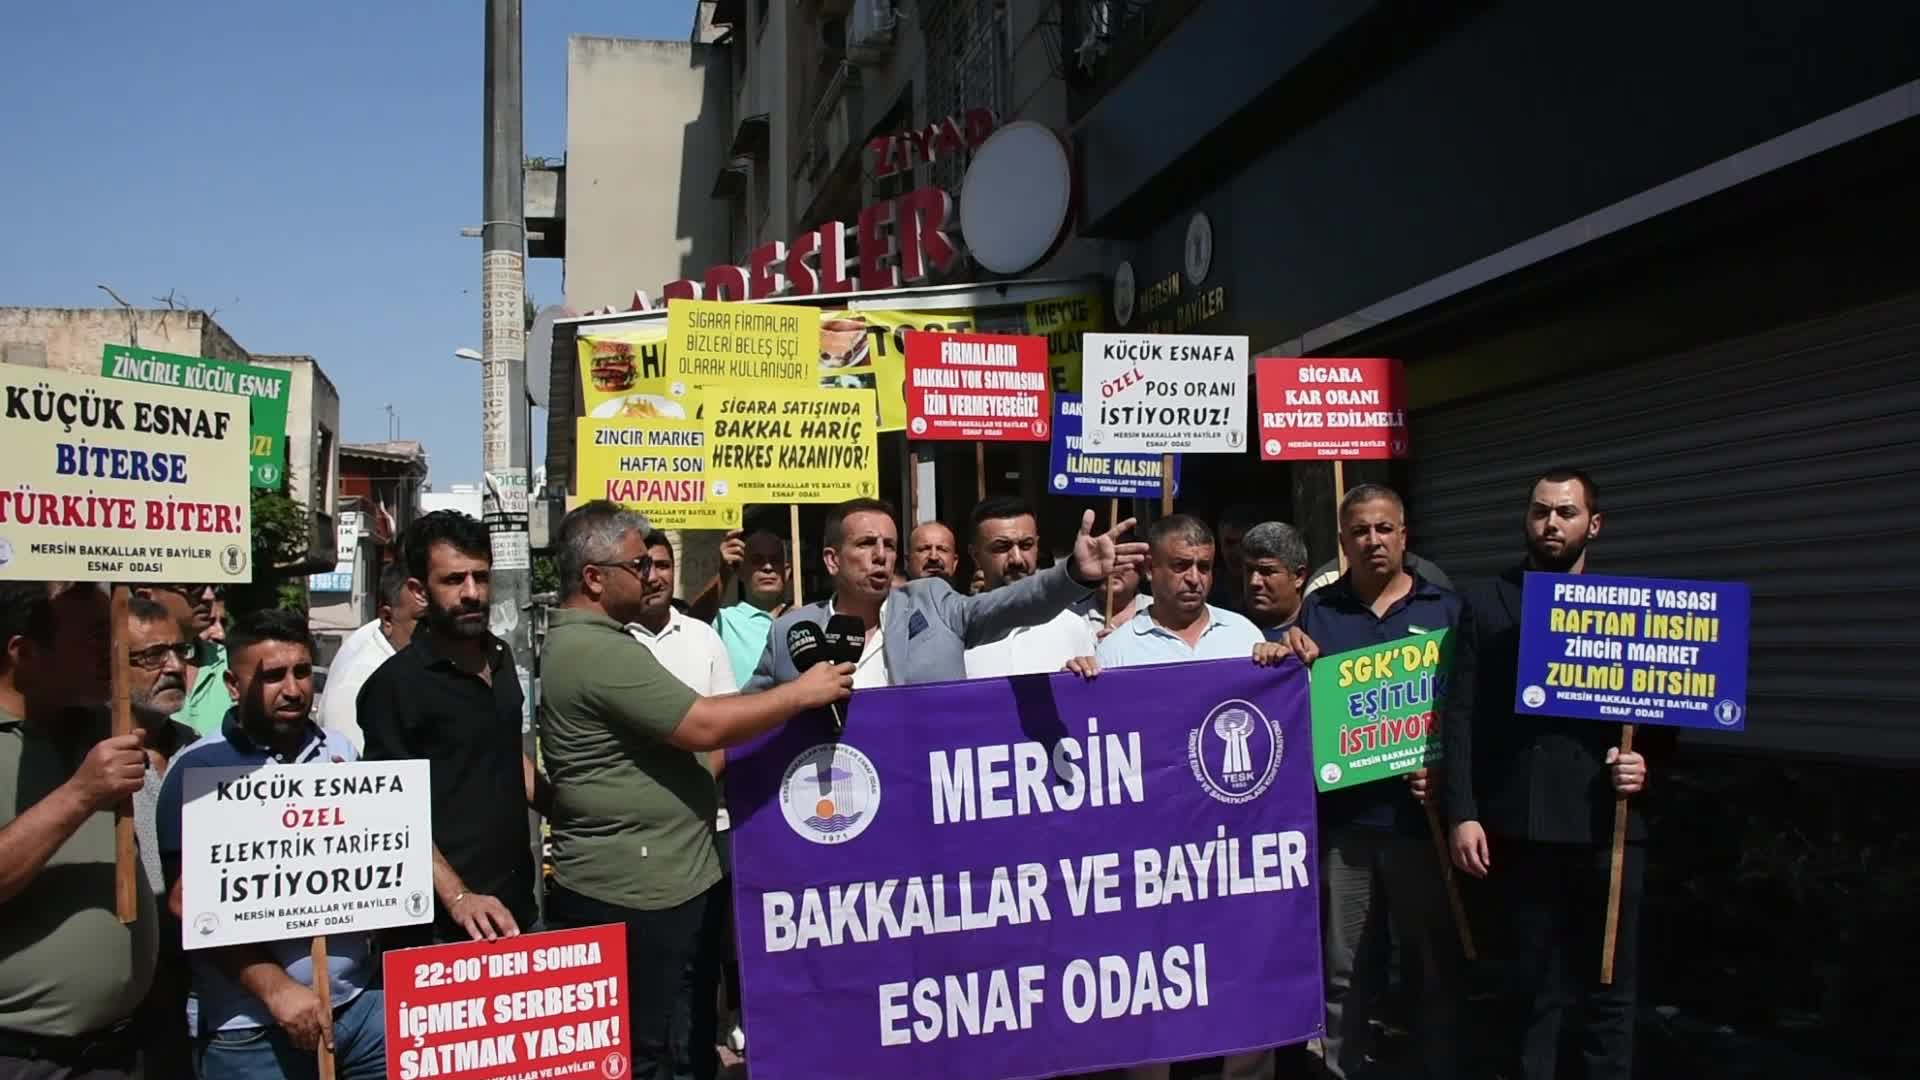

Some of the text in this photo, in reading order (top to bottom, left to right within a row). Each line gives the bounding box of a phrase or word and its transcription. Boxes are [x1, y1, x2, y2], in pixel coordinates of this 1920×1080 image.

[688, 307, 799, 334] SİGARA FİRMALARI
[687, 331, 799, 360] BİZLERİ BELEŞ İŞÇİ
[941, 337, 1018, 367] FİRMALARIN
[1104, 340, 1235, 365] KÜÇÜK ESNAFA
[112, 352, 181, 386] ZİNCİRLE
[238, 373, 283, 400] ESNAF
[679, 357, 725, 376] OLARAK
[730, 360, 808, 380] KULLANIYOR!
[913, 368, 960, 388] BAKKALI
[961, 370, 983, 389] YOK
[984, 371, 1046, 391] SAYMASINA
[1299, 364, 1363, 383] SİGARA
[1100, 368, 1144, 398] ÖZEL
[1146, 381, 1236, 397] POS ORANI
[720, 396, 777, 415] SİGARA
[781, 401, 860, 419] SATIŞINDA
[924, 389, 947, 416] İZİN
[949, 391, 1040, 418] VERMEYECEĞİZ!
[1285, 390, 1379, 405] KAR ORANI
[6, 383, 230, 440] KÜÇÜK ESNAF
[1101, 400, 1230, 426] İSTİYORUZ!
[1263, 409, 1404, 428] REVİZE EDİLMELİ
[595, 426, 643, 446] ZİNCİR
[714, 417, 862, 445] BAKKAL HARİÇ
[56, 438, 188, 483] BİTERSE
[620, 457, 668, 473] HAFTA
[712, 444, 870, 471] HERKES KAZANIYOR!
[1066, 453, 1111, 475] İLİNDE
[606, 479, 705, 502] KAPANSI
[0, 484, 241, 534] TÜRKİYE BİTER!
[31, 541, 212, 559] MERSİN BAKKALLAR VE BAYİLER
[87, 561, 163, 573] ESNAF ODASI
[1554, 583, 1717, 611] PERAKENDE YASASI
[1550, 608, 1719, 642] RAFTAN İNSİN!
[1339, 640, 1439, 687] SGK'DA
[1564, 636, 1699, 665] ZİNCİR MARKET
[1545, 662, 1716, 698] ZULMÜ BİTSİN!
[1348, 671, 1448, 721] EŞİTLİK
[1556, 691, 1708, 711] MERSİN BAKKALLAR VE BAYİLER
[1600, 705, 1664, 718] ESNAF ODASI
[929, 717, 1145, 825] MERSİN
[1349, 756, 1381, 768] MERSİN
[1390, 758, 1417, 770] ESNAF
[217, 774, 403, 805] KÜÇÜK ESNAFA
[1222, 772, 1254, 783] TESK
[282, 803, 345, 828] ÖZEL
[210, 825, 410, 864] ELEKTRİK TARİFESİ
[822, 833, 848, 842] 1971
[220, 862, 404, 902] İSTİYORUZ!
[761, 824, 1310, 953] BAKKALLAR VE BAYİLER
[234, 897, 397, 921] MERSİN BAKKALLAR VE BAYİLER
[286, 916, 354, 930] ESNAF ODASI
[415, 942, 601, 988] 22:00'DEN SONRA
[879, 942, 1209, 1047] ESNAF ODASI
[399, 976, 618, 1047] İÇMEK SERBEST!
[400, 1015, 620, 1080] SATMAK YASAK!
[541, 1067, 553, 1078] VE
[554, 1061, 596, 1075] BAYİLER
